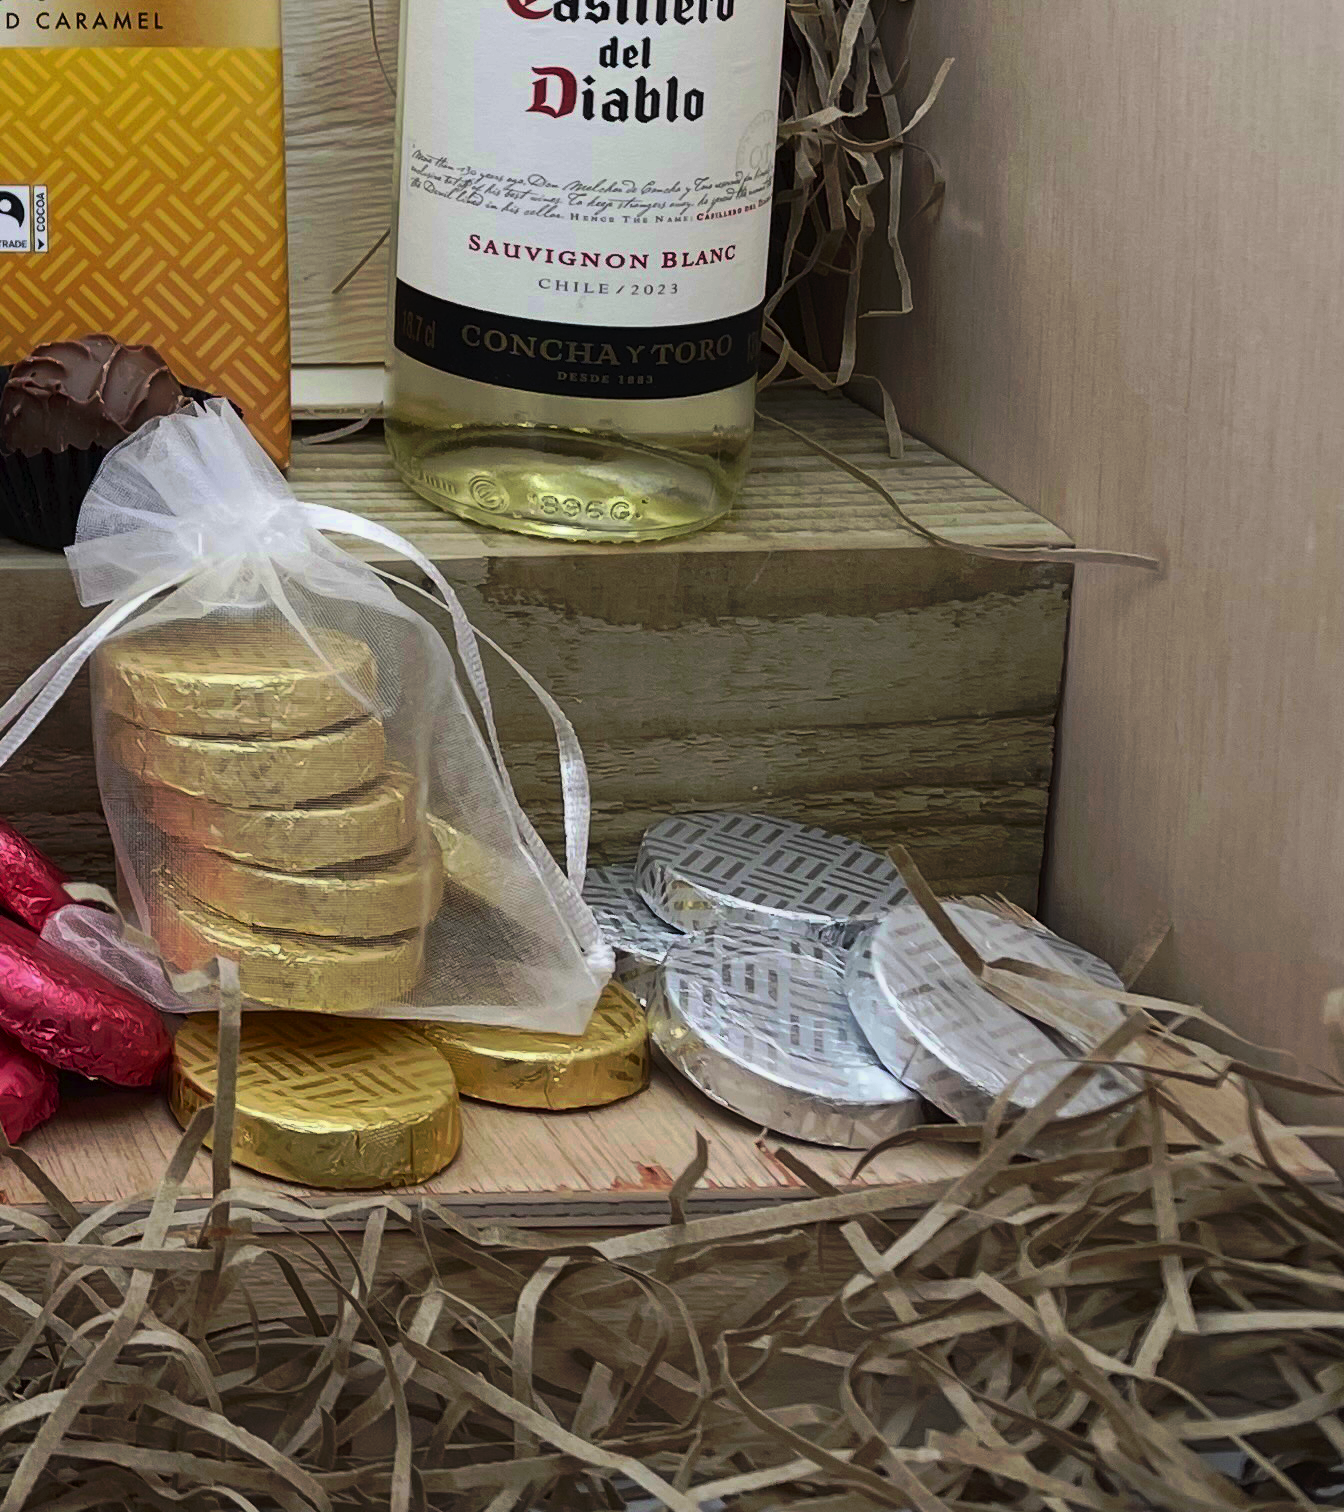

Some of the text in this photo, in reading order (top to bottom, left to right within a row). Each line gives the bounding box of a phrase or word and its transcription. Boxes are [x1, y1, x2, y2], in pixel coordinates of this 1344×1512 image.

[35, 11, 165, 30] CARAMEL
[598, 35, 652, 69] del
[524, 66, 705, 124] Diablo
[35, 192, 46, 233] COCOA
[468, 234, 737, 270] SAUVIGNON BLANC
[461, 324, 622, 366] CONCHA
[626, 344, 647, 365] Y
[650, 333, 733, 366] TORO
[556, 370, 610, 385] DESDE
